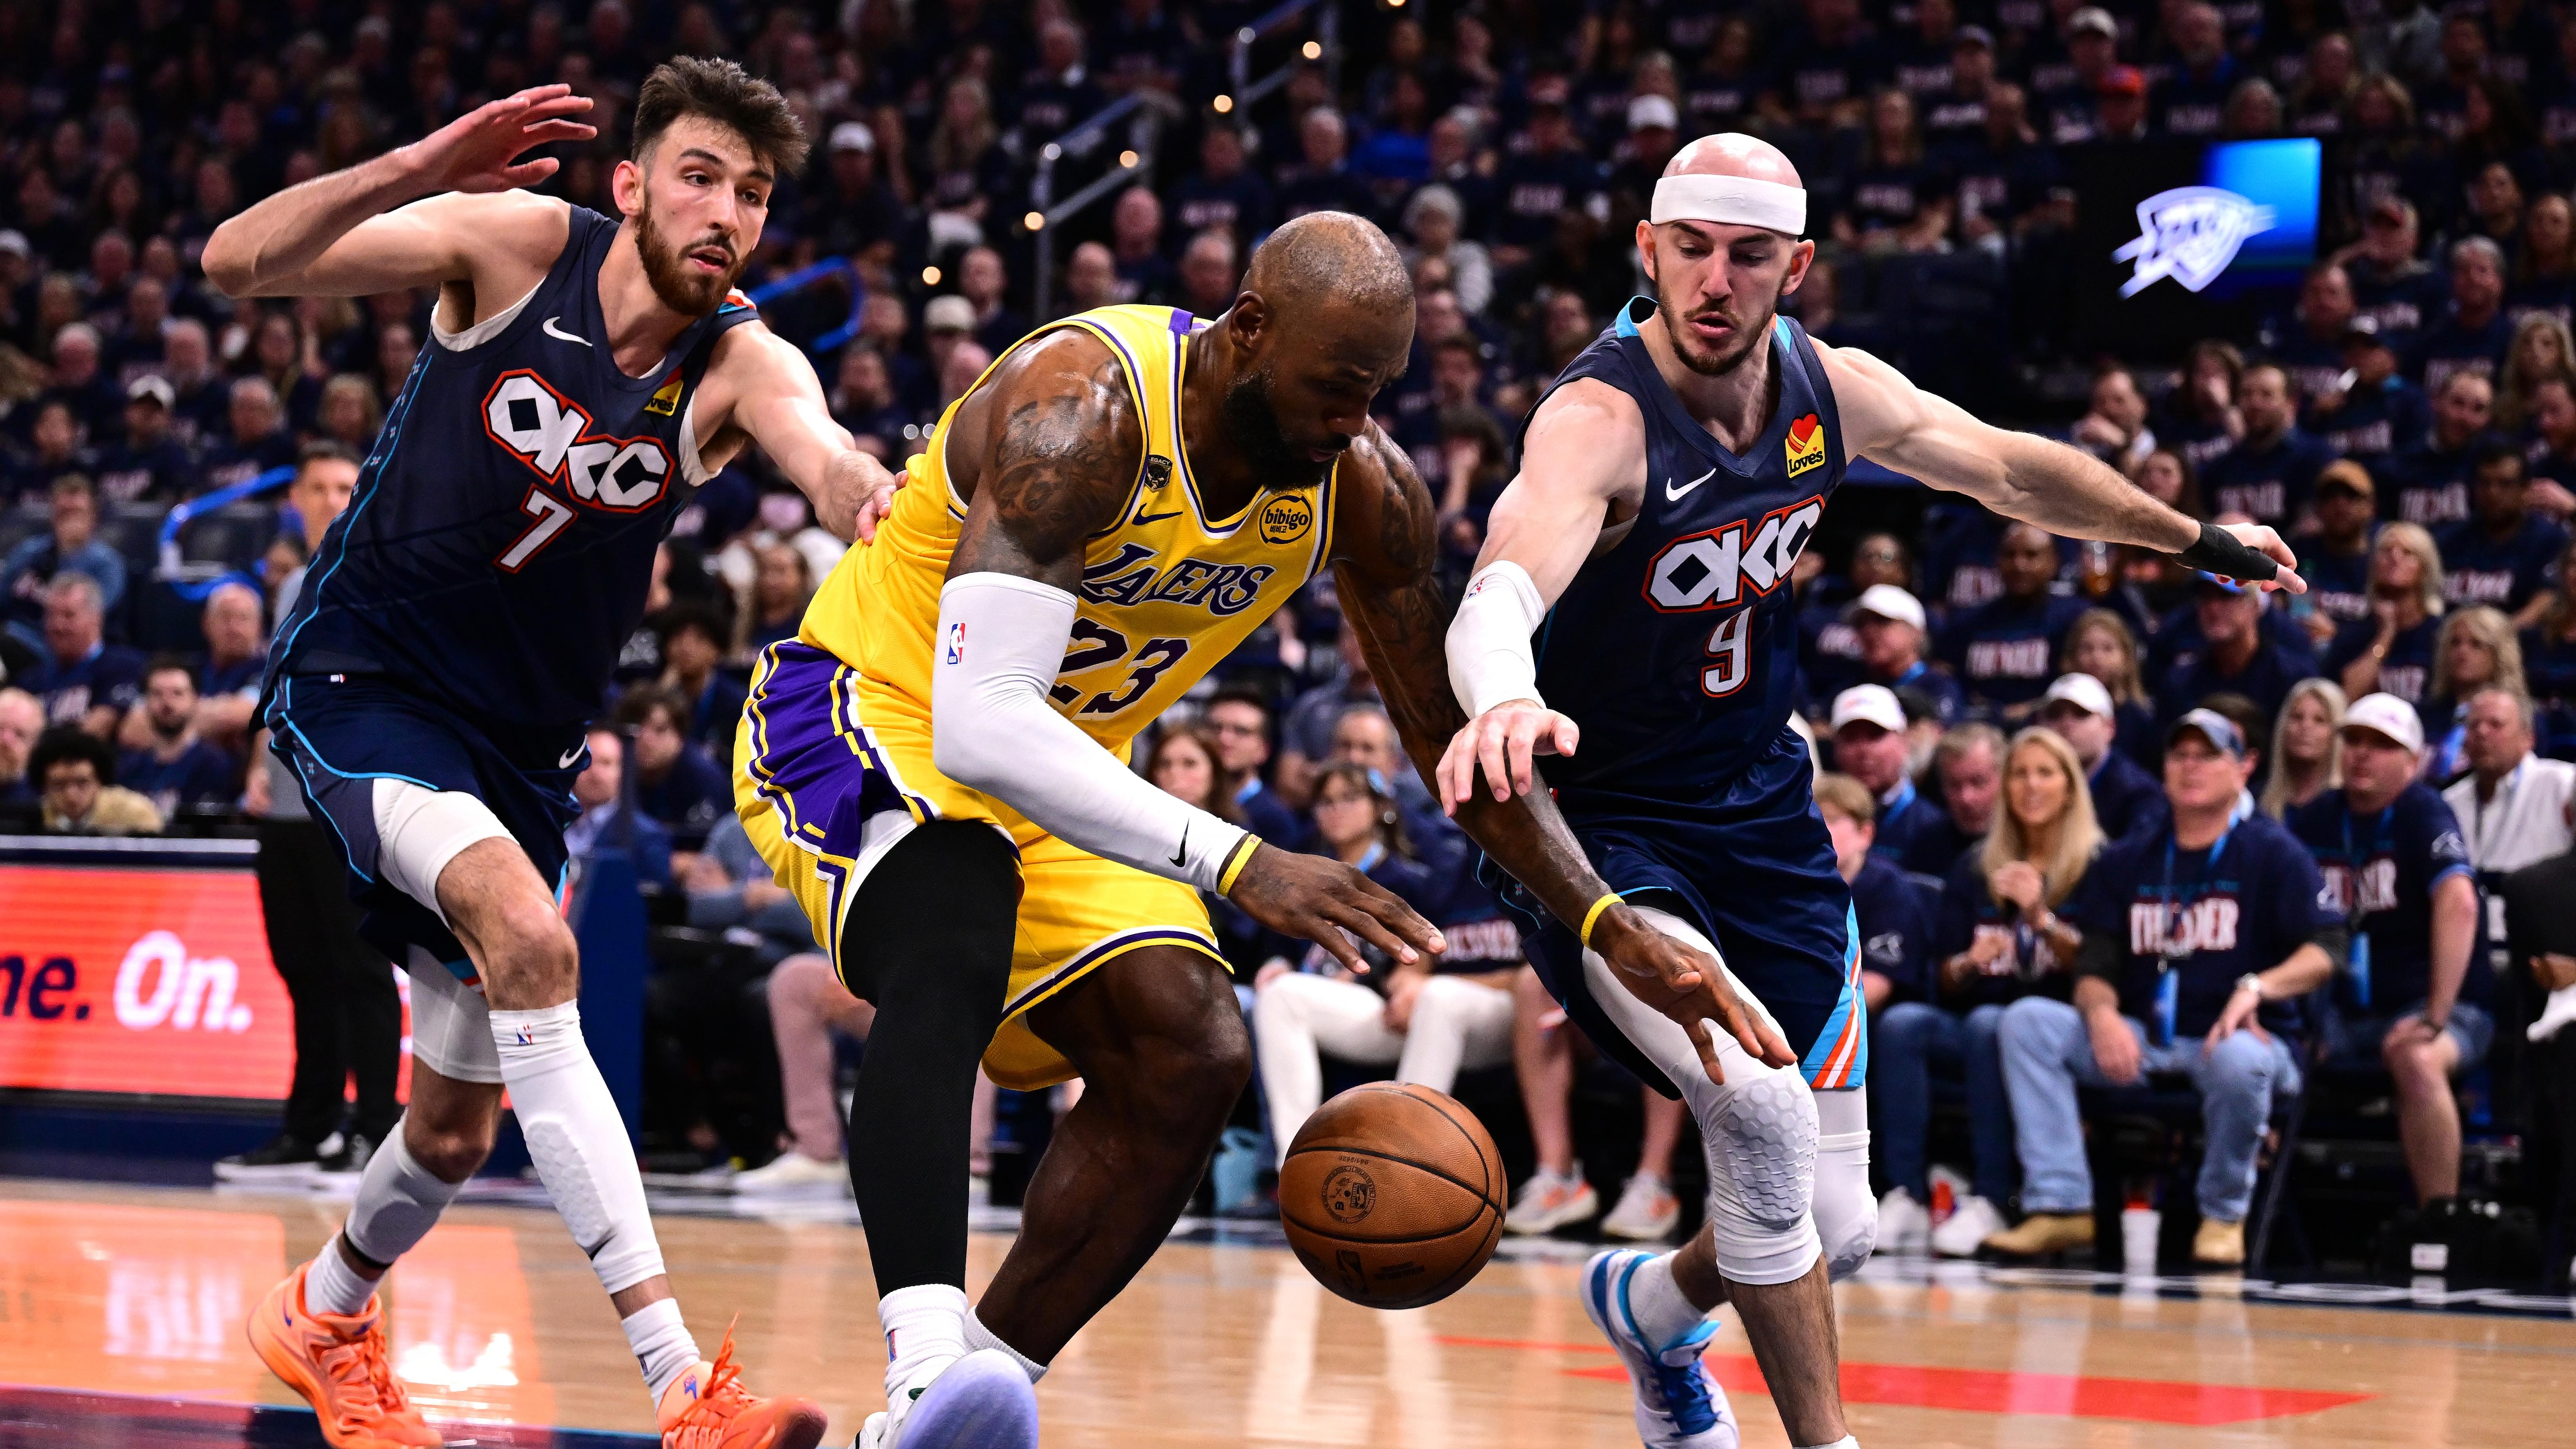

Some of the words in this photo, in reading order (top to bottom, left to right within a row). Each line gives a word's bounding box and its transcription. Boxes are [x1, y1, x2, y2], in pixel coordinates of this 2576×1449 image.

[481, 368, 675, 513] OKC
[493, 483, 579, 574] 7
[1264, 508, 1309, 530] bibigo
[1641, 494, 1825, 613] OKC
[1049, 616, 1192, 720] 23
[1701, 605, 1755, 698] 9
[113, 931, 252, 1033] On.
